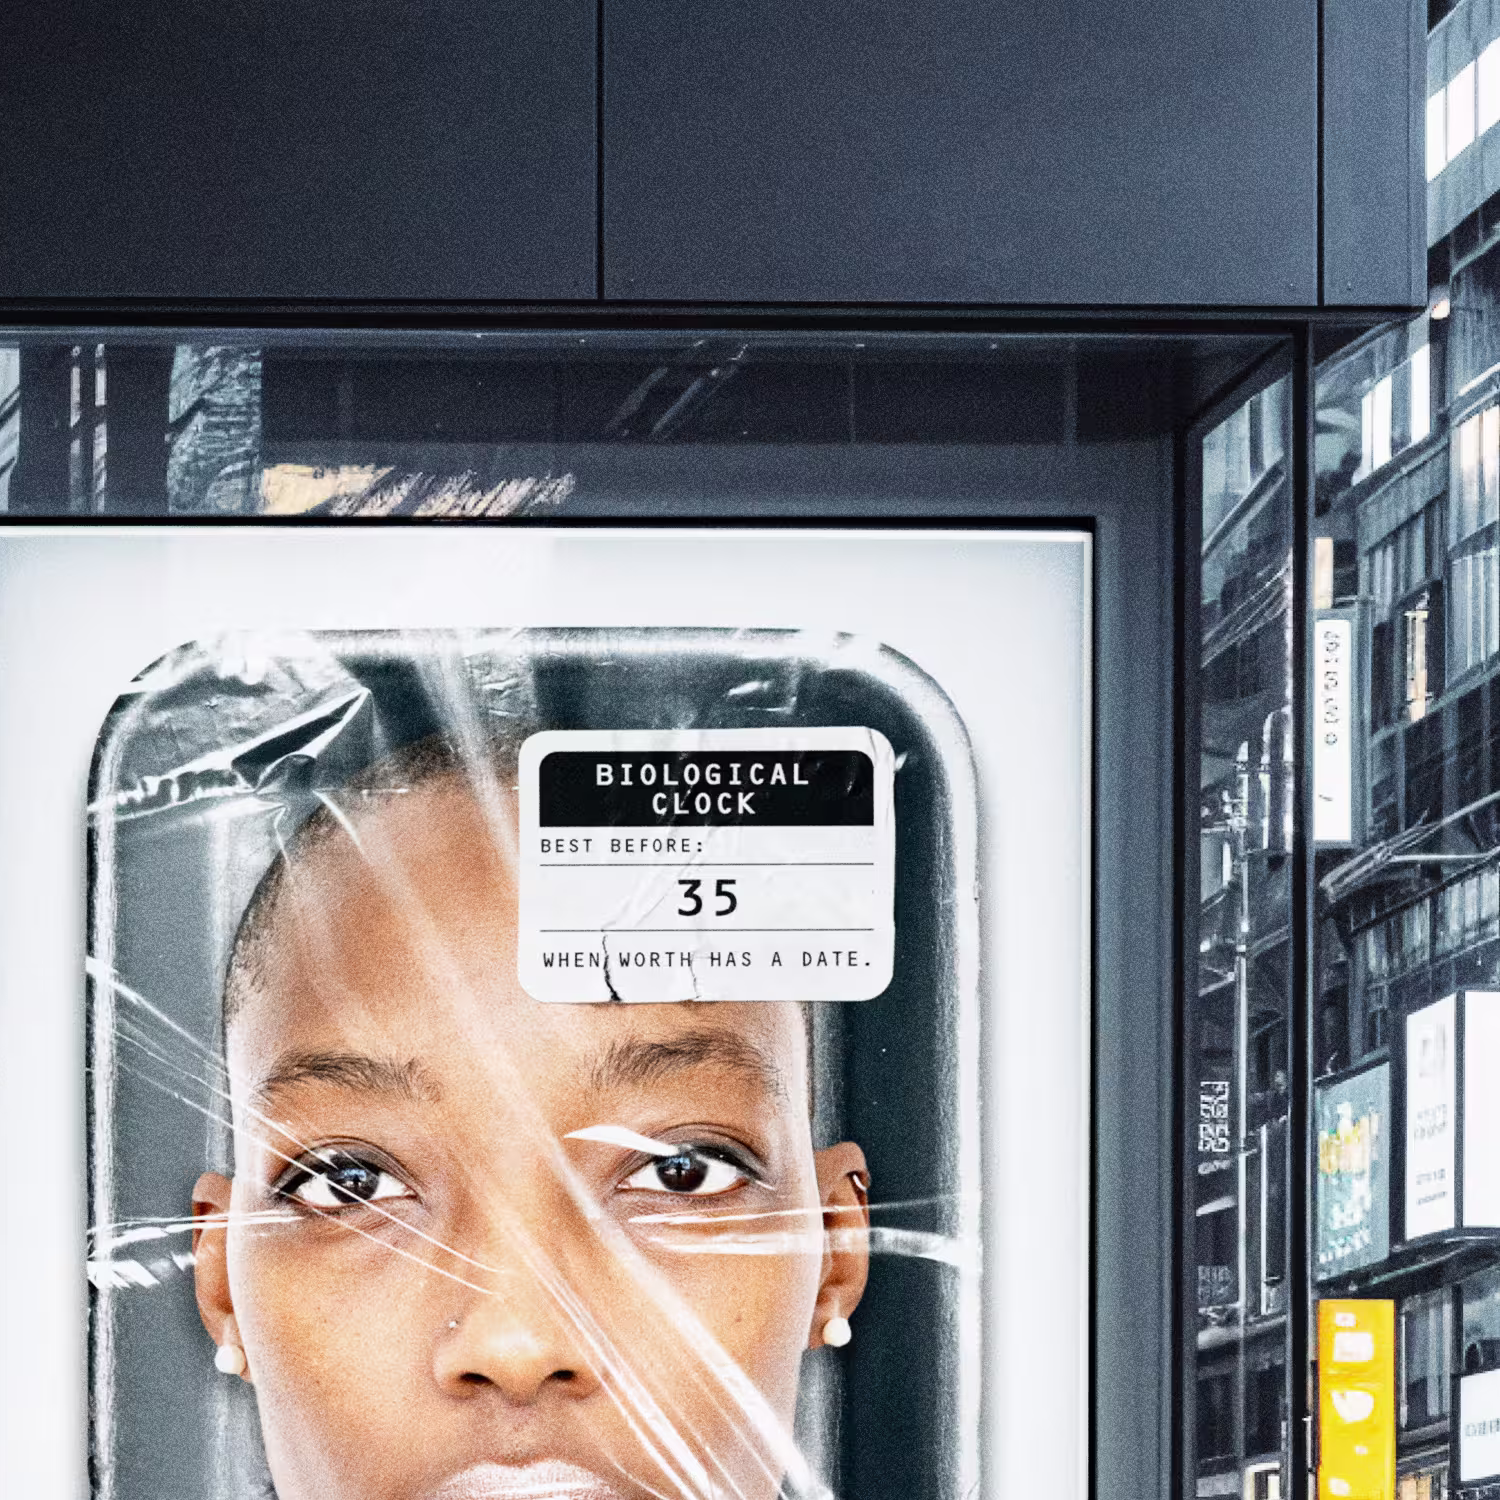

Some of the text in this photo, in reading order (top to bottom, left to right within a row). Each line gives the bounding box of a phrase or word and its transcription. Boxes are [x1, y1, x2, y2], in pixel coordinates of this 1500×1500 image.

[597, 763, 808, 785] BIOLOGICAL
[653, 792, 755, 815] CLOCK
[541, 838, 701, 853] BEST BEFORE:
[678, 880, 737, 916] 35
[543, 951, 869, 967] WHEN WORTH HAS A DATE.
